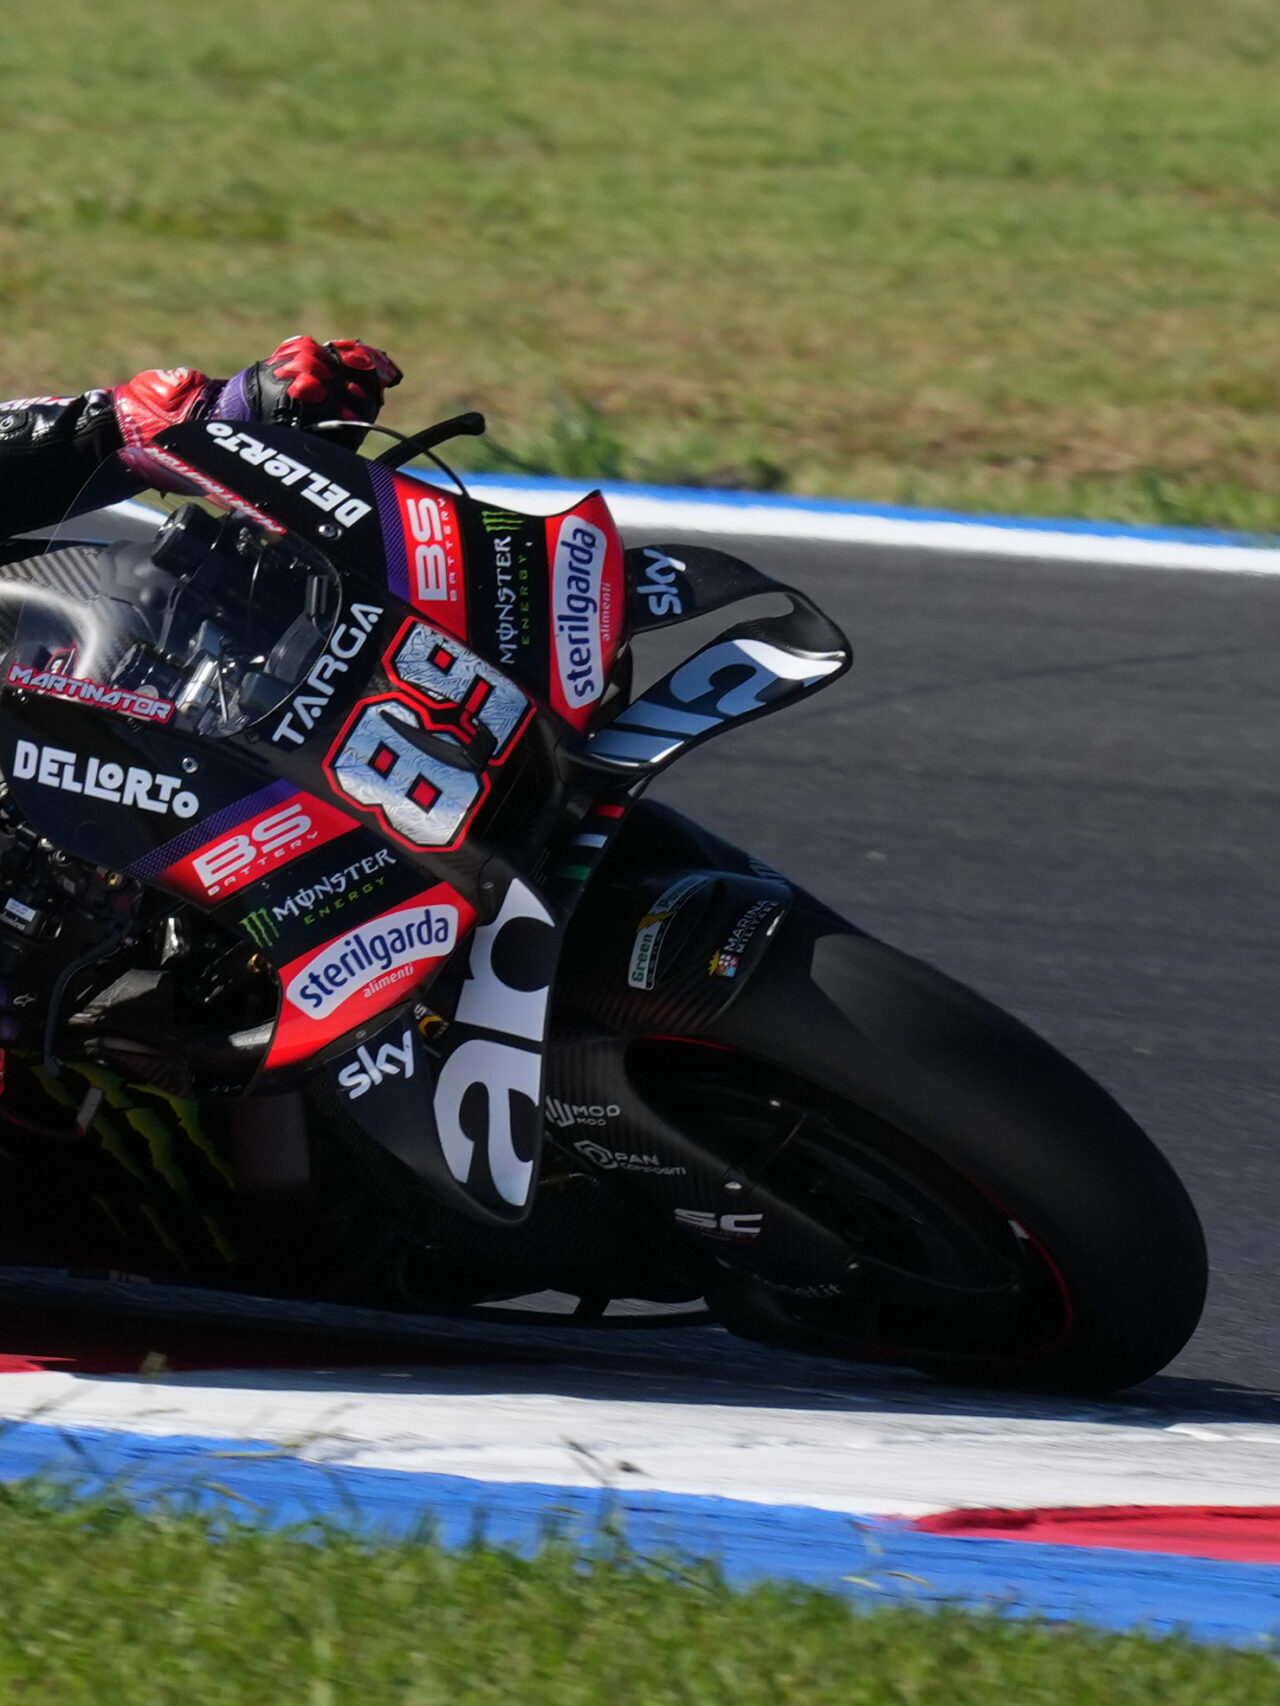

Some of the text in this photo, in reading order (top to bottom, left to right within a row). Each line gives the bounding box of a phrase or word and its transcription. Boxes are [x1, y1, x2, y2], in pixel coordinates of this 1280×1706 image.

[206, 421, 373, 528] DELLORTO
[406, 496, 448, 601] BS
[636, 548, 686, 616] sky
[493, 535, 517, 665] MONSTER
[520, 555, 530, 646] ENERGY
[558, 527, 598, 698] sterilgarda
[601, 581, 611, 641] alimenti
[9, 664, 175, 723] MARTINATOR
[272, 602, 384, 746] TARGA
[324, 616, 537, 852] 89
[13, 740, 199, 818] DELLORTO
[192, 803, 313, 888] BS
[207, 830, 319, 896] BATTERY
[271, 848, 397, 923] MONSTER
[304, 876, 386, 925] ENERGY
[300, 909, 450, 1009] sterilgarda
[363, 962, 415, 999] alimenti
[631, 933, 654, 983] Green
[337, 1030, 416, 1100] sky
